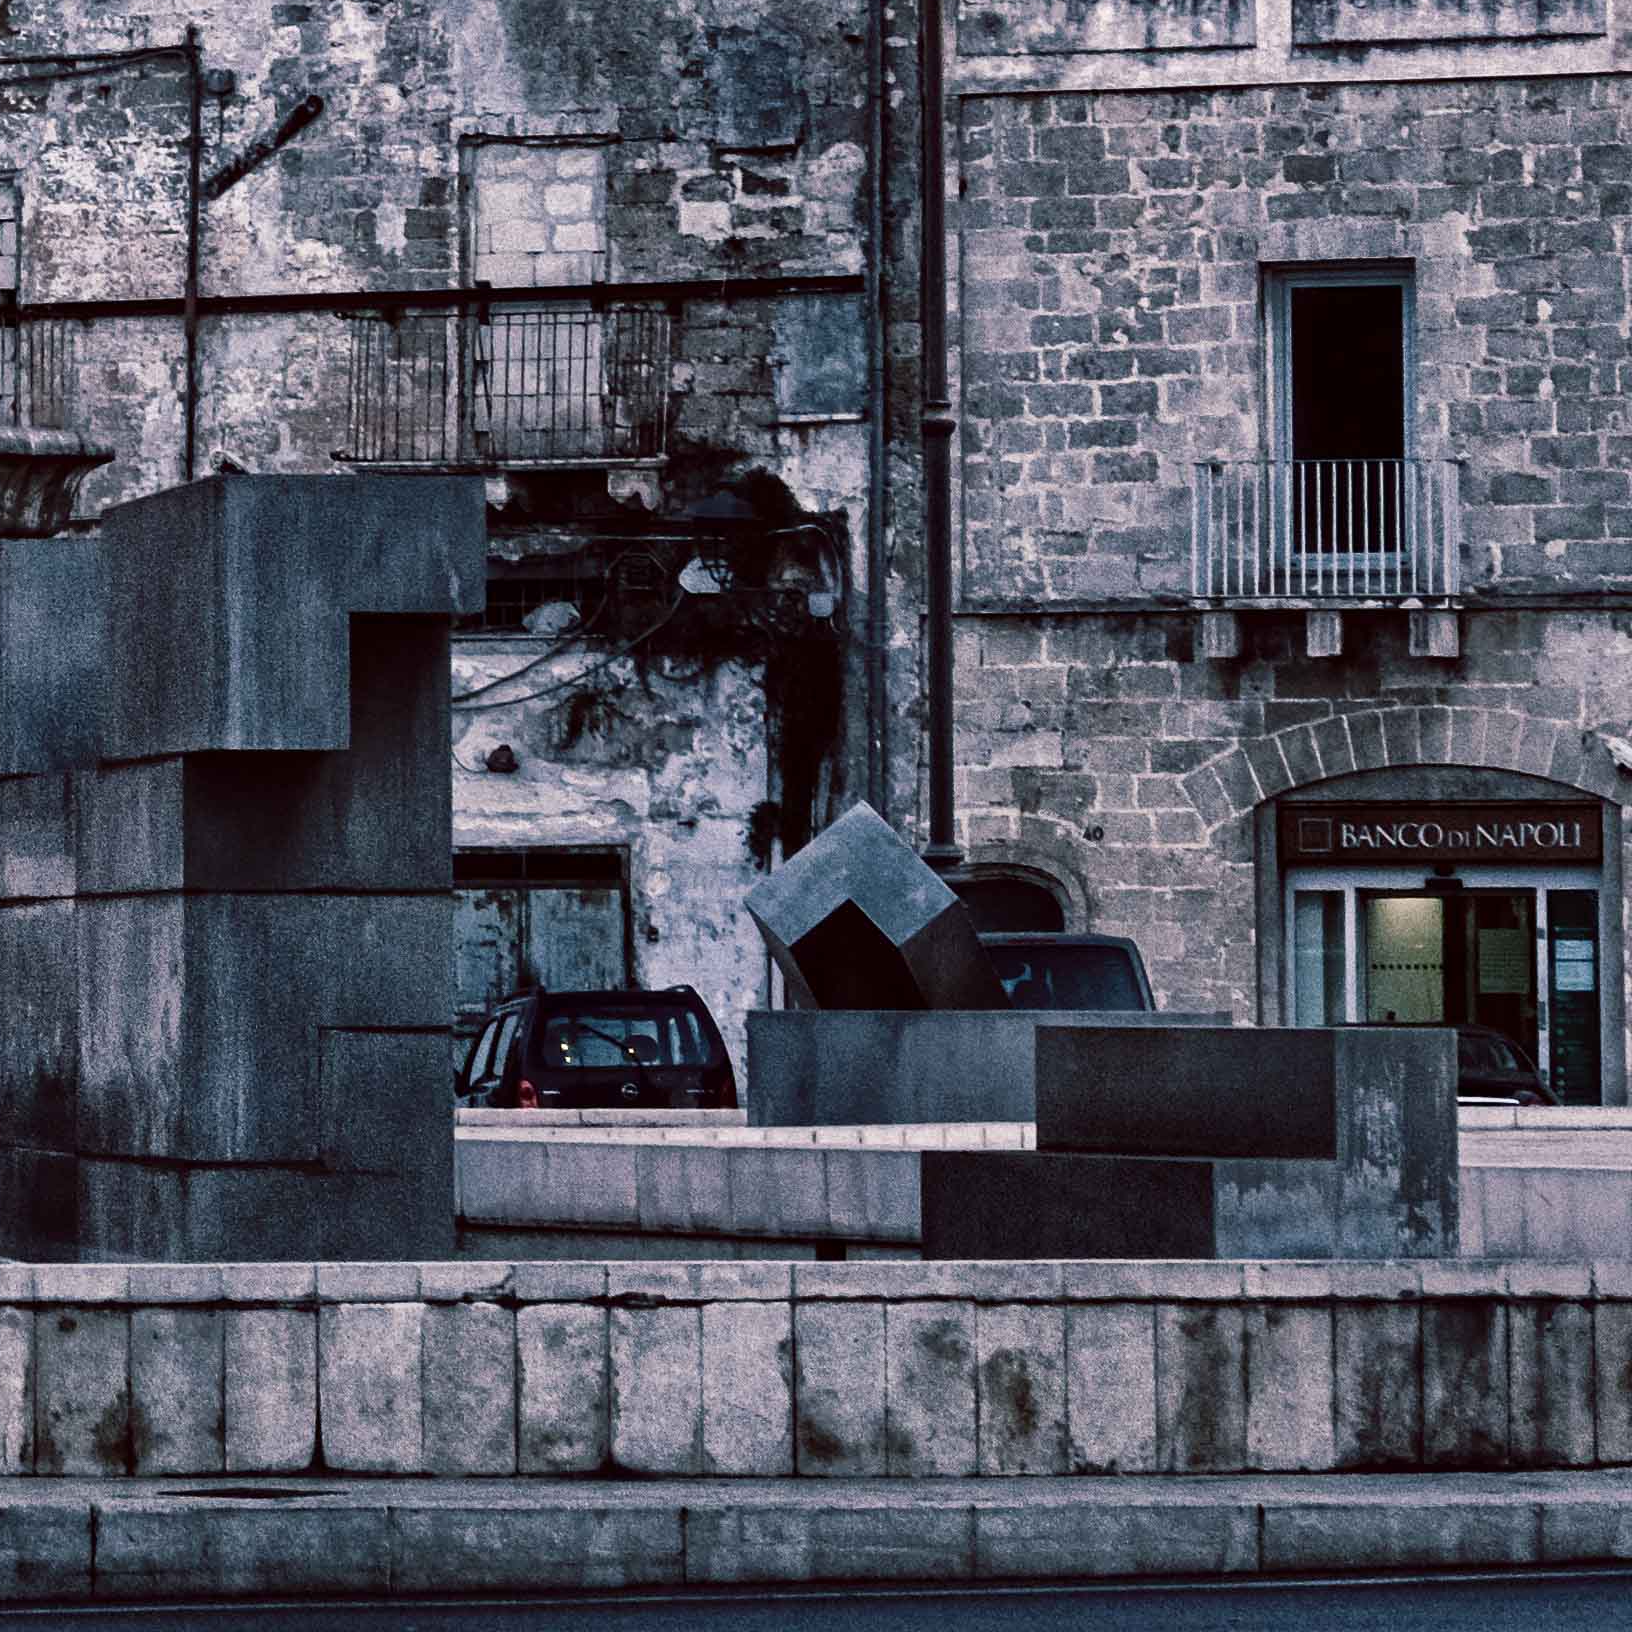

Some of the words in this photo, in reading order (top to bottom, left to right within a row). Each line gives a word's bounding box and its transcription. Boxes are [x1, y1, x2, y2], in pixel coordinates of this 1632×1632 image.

[1341, 822, 1443, 848] BANCO
[1448, 830, 1470, 847] DI
[1476, 822, 1581, 848] NAPOLI
